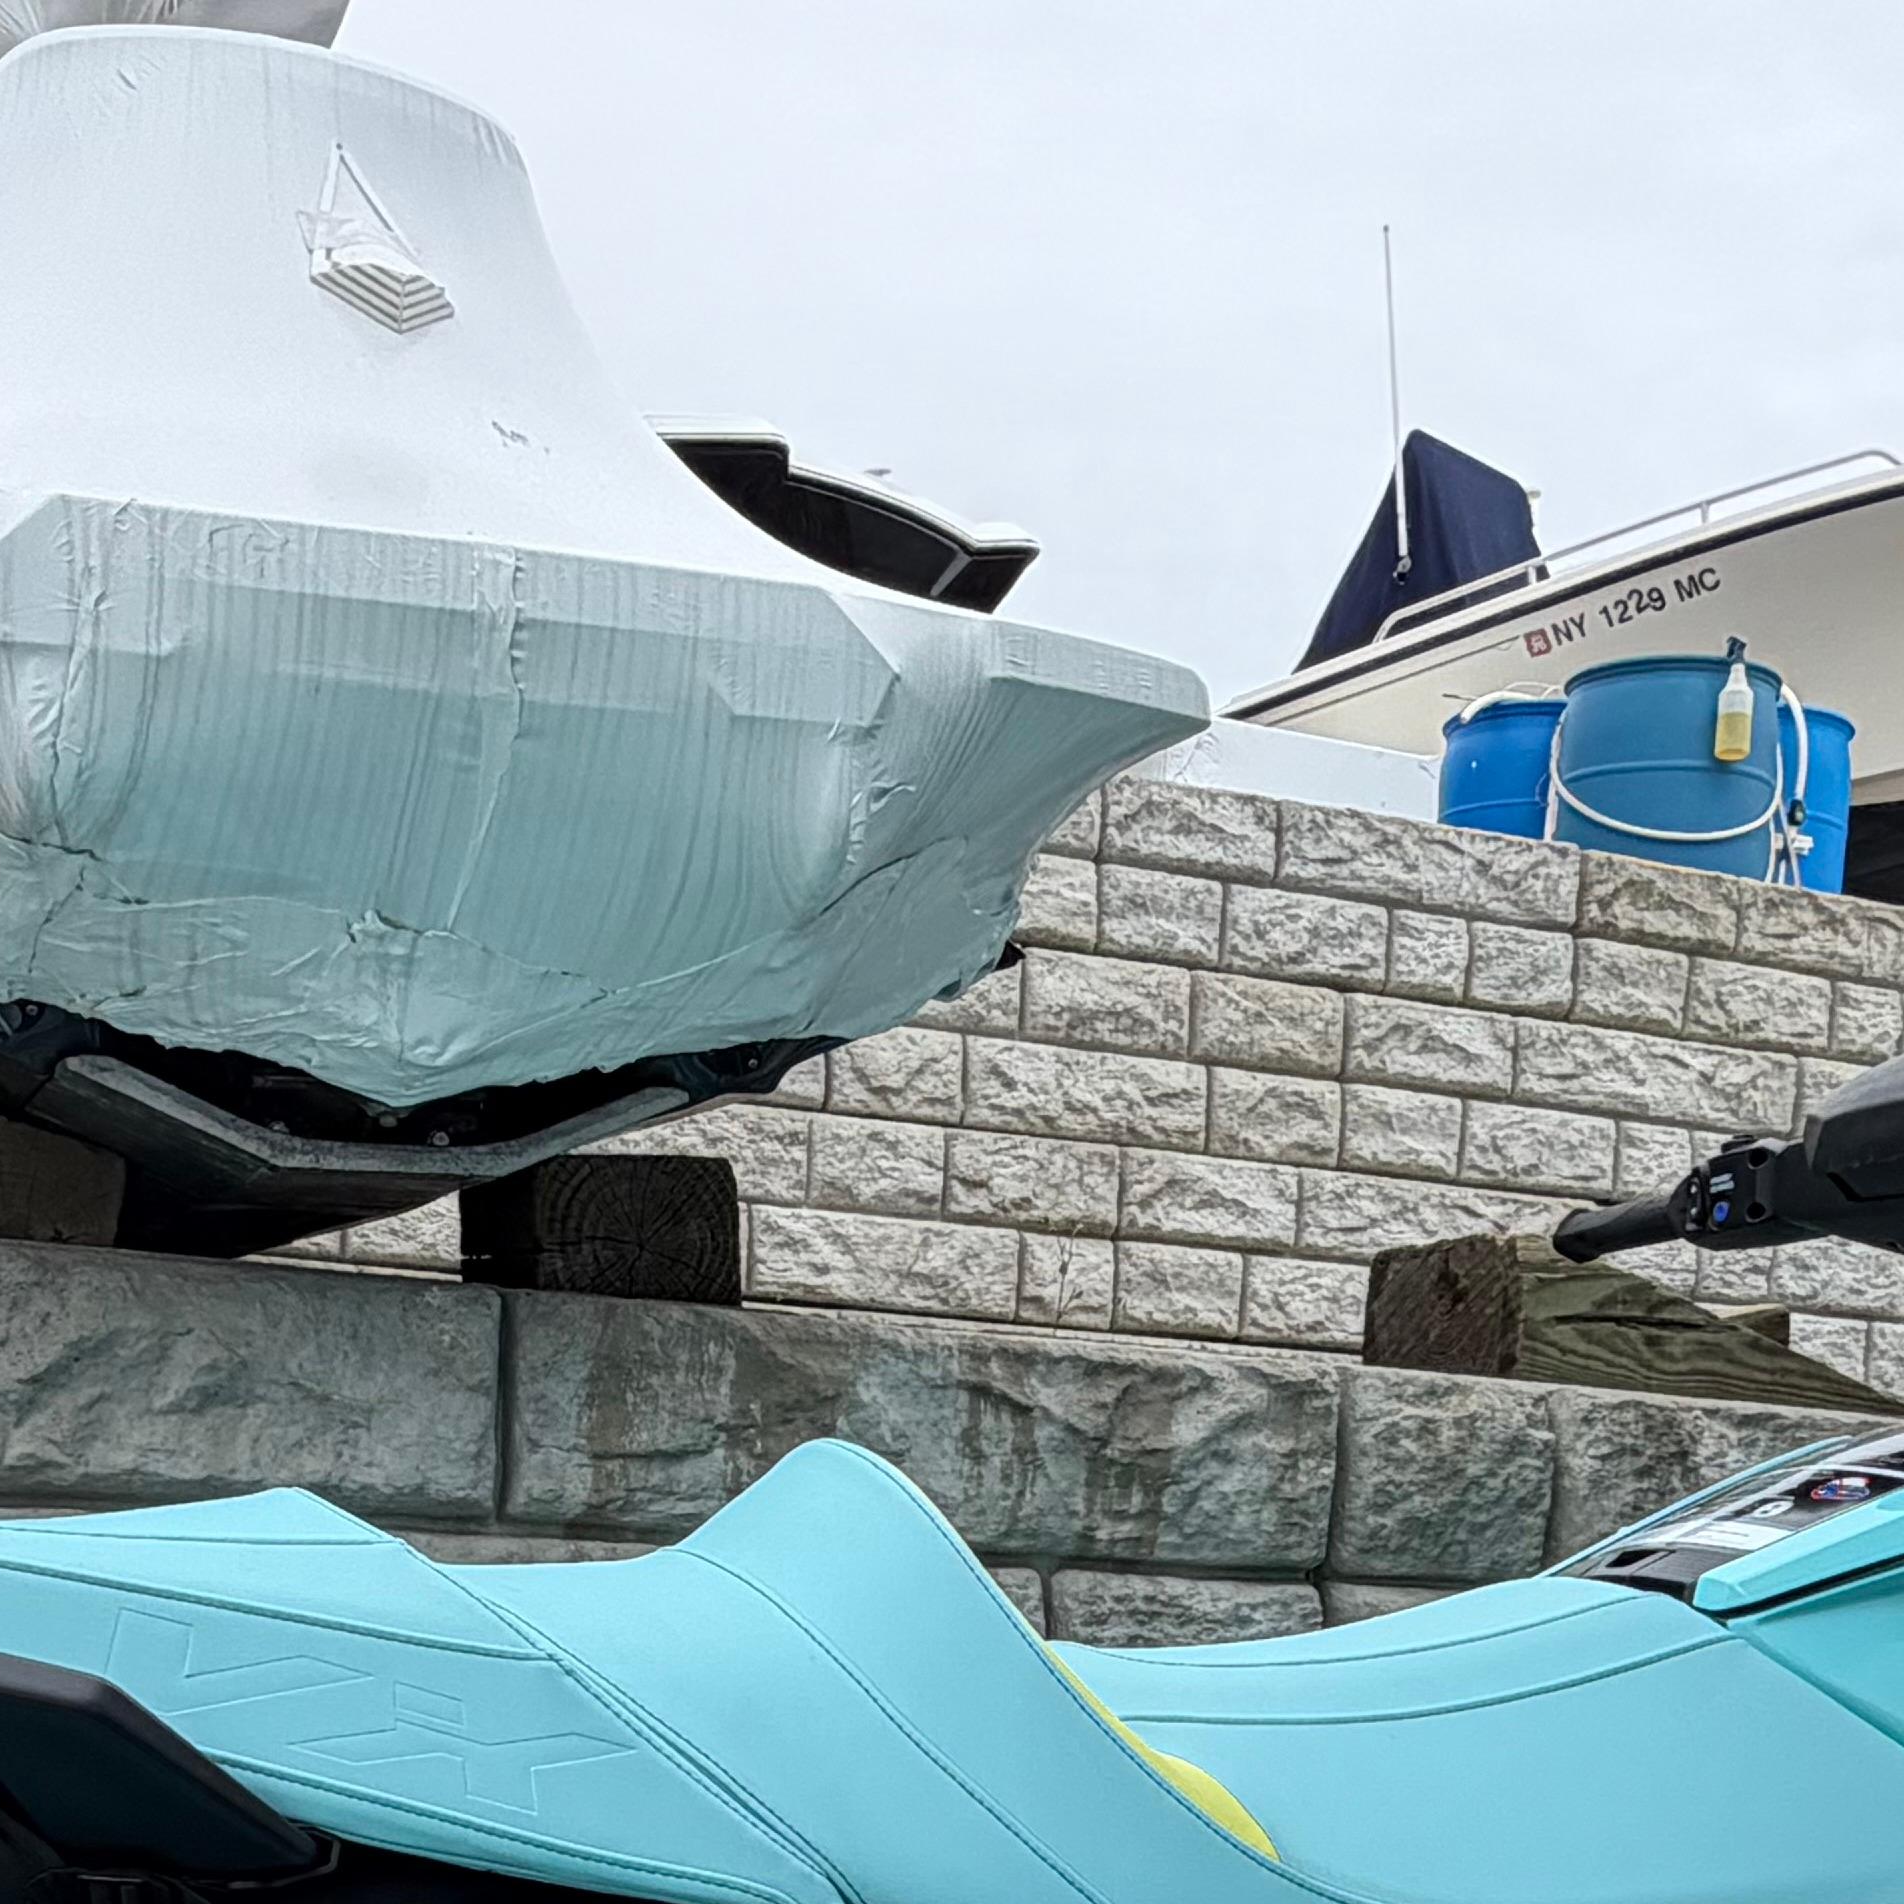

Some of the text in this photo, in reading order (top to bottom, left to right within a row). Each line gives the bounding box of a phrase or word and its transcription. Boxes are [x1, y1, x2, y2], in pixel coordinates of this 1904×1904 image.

[1551, 612, 1586, 646] NY
[1599, 587, 1666, 628] 1229
[1673, 567, 1721, 602] MC
